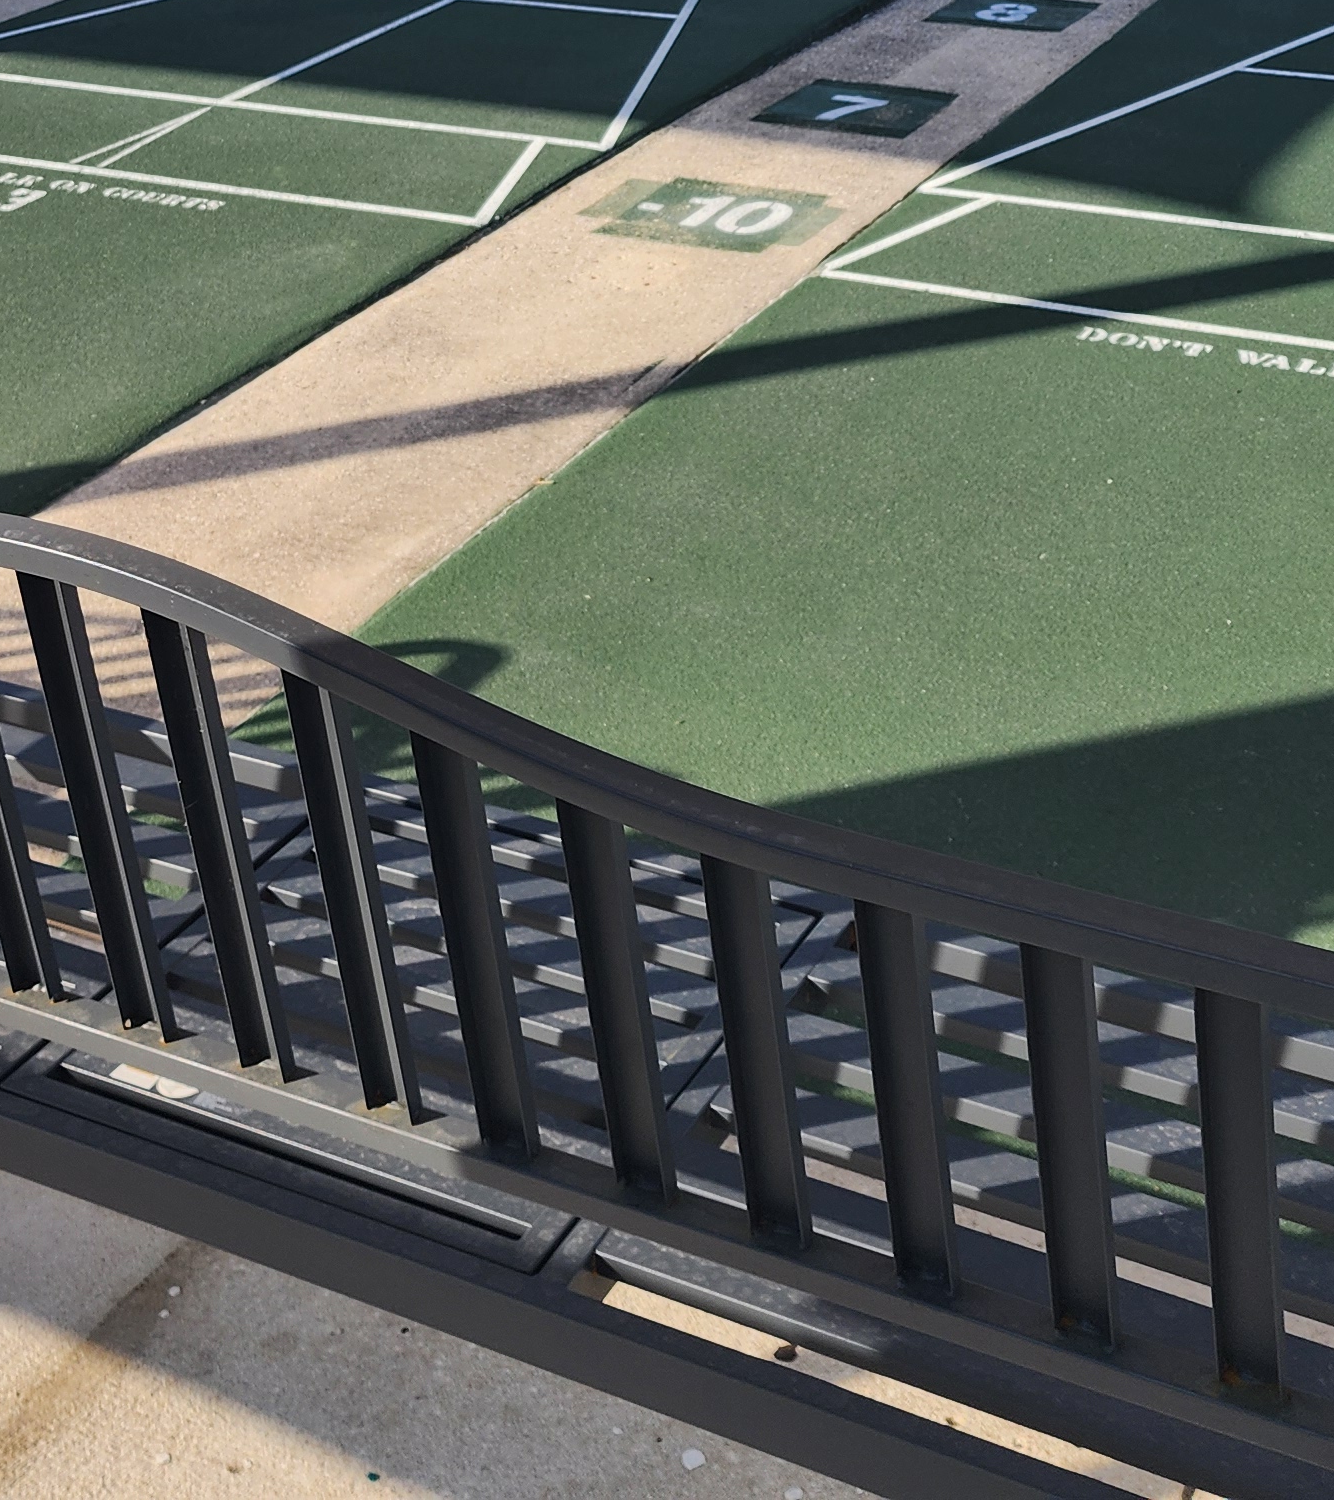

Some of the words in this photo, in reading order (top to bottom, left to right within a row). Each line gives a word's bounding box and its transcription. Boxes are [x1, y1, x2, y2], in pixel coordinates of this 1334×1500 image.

[974, 3, 1038, 25] 8
[814, 94, 890, 121] 7
[1075, 326, 1215, 357] DON'T
